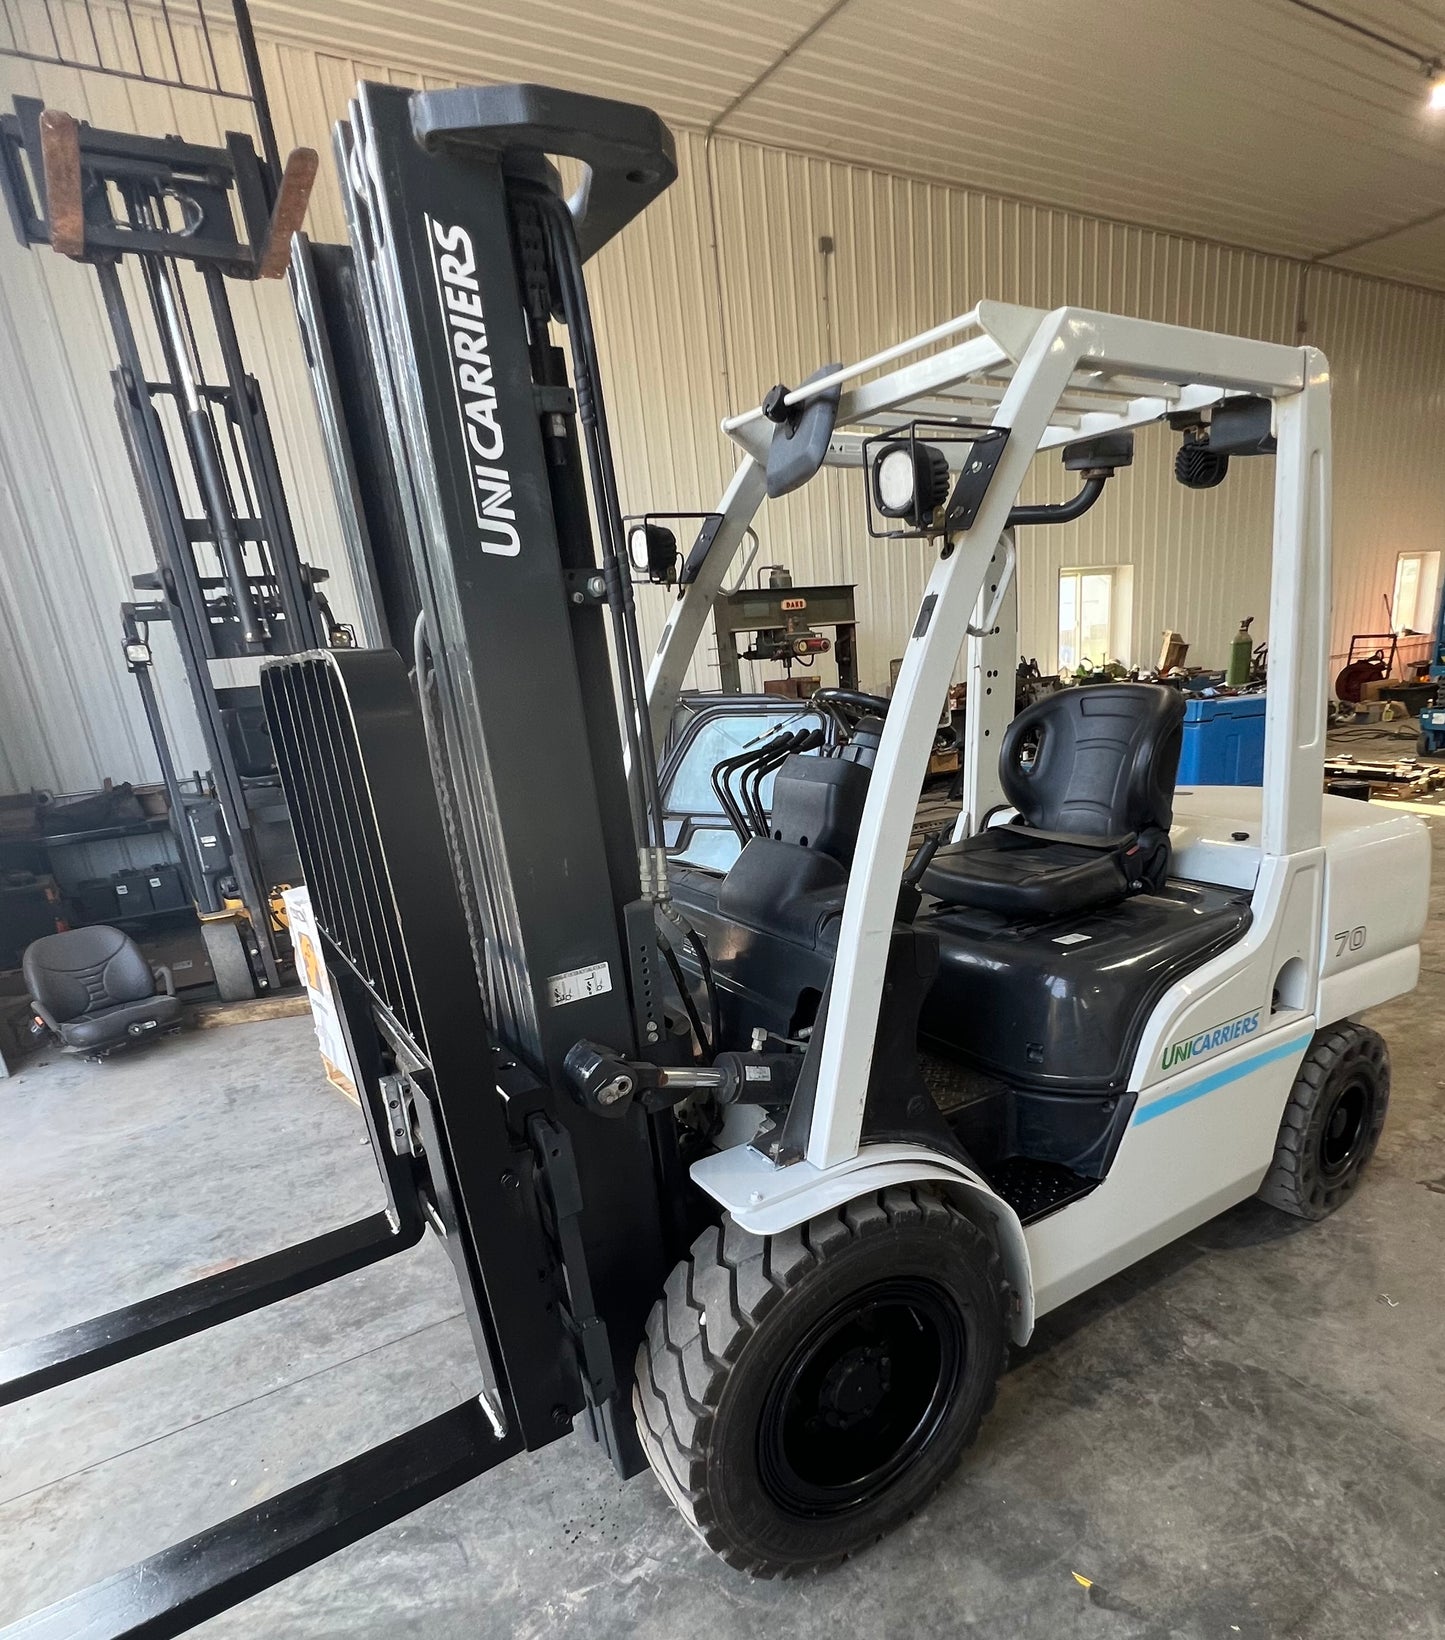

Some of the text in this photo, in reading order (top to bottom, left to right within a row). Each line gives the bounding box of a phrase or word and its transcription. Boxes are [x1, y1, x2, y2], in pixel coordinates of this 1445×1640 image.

[425, 214, 520, 557] UNICARRIERS
[1334, 925, 1367, 957] 70
[1161, 1008, 1261, 1070] UNICARRIERS
